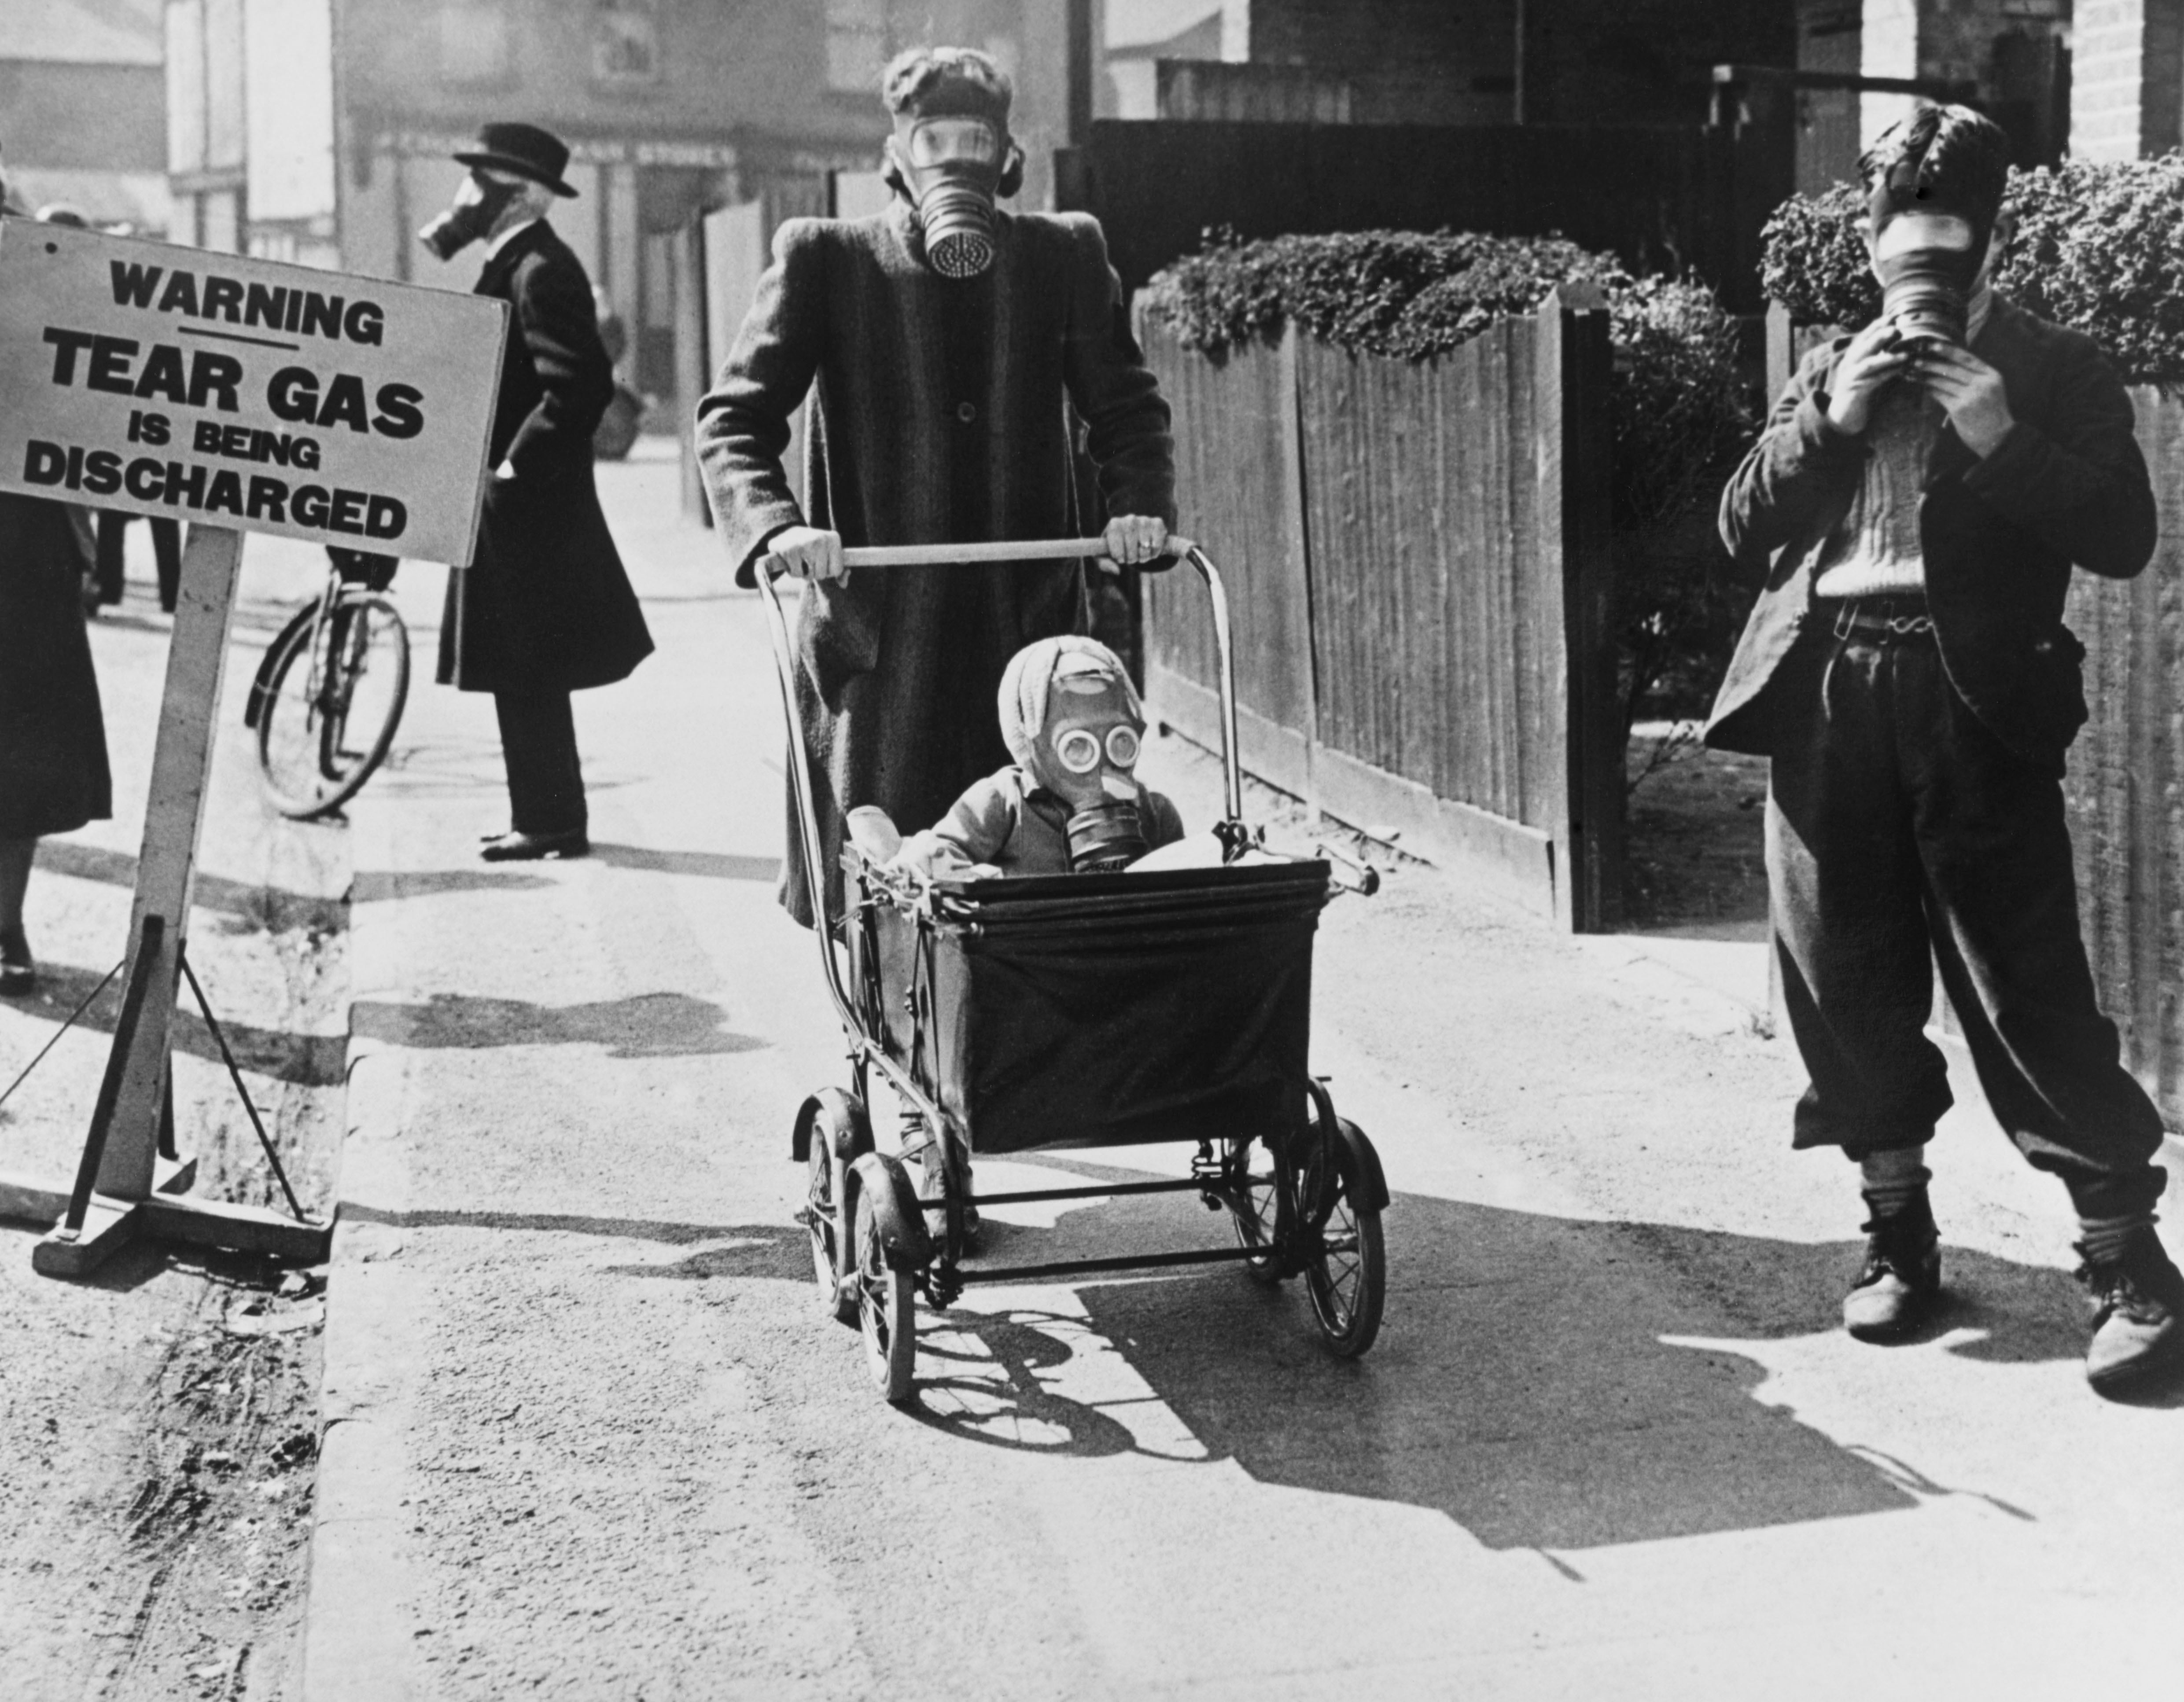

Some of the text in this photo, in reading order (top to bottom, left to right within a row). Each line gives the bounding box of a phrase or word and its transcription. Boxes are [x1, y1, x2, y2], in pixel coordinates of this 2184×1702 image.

[110, 260, 384, 347] WARNING
[43, 326, 424, 439] TEAR GAS
[127, 410, 320, 471] IS BEING
[23, 438, 407, 540] DISCHARGED
